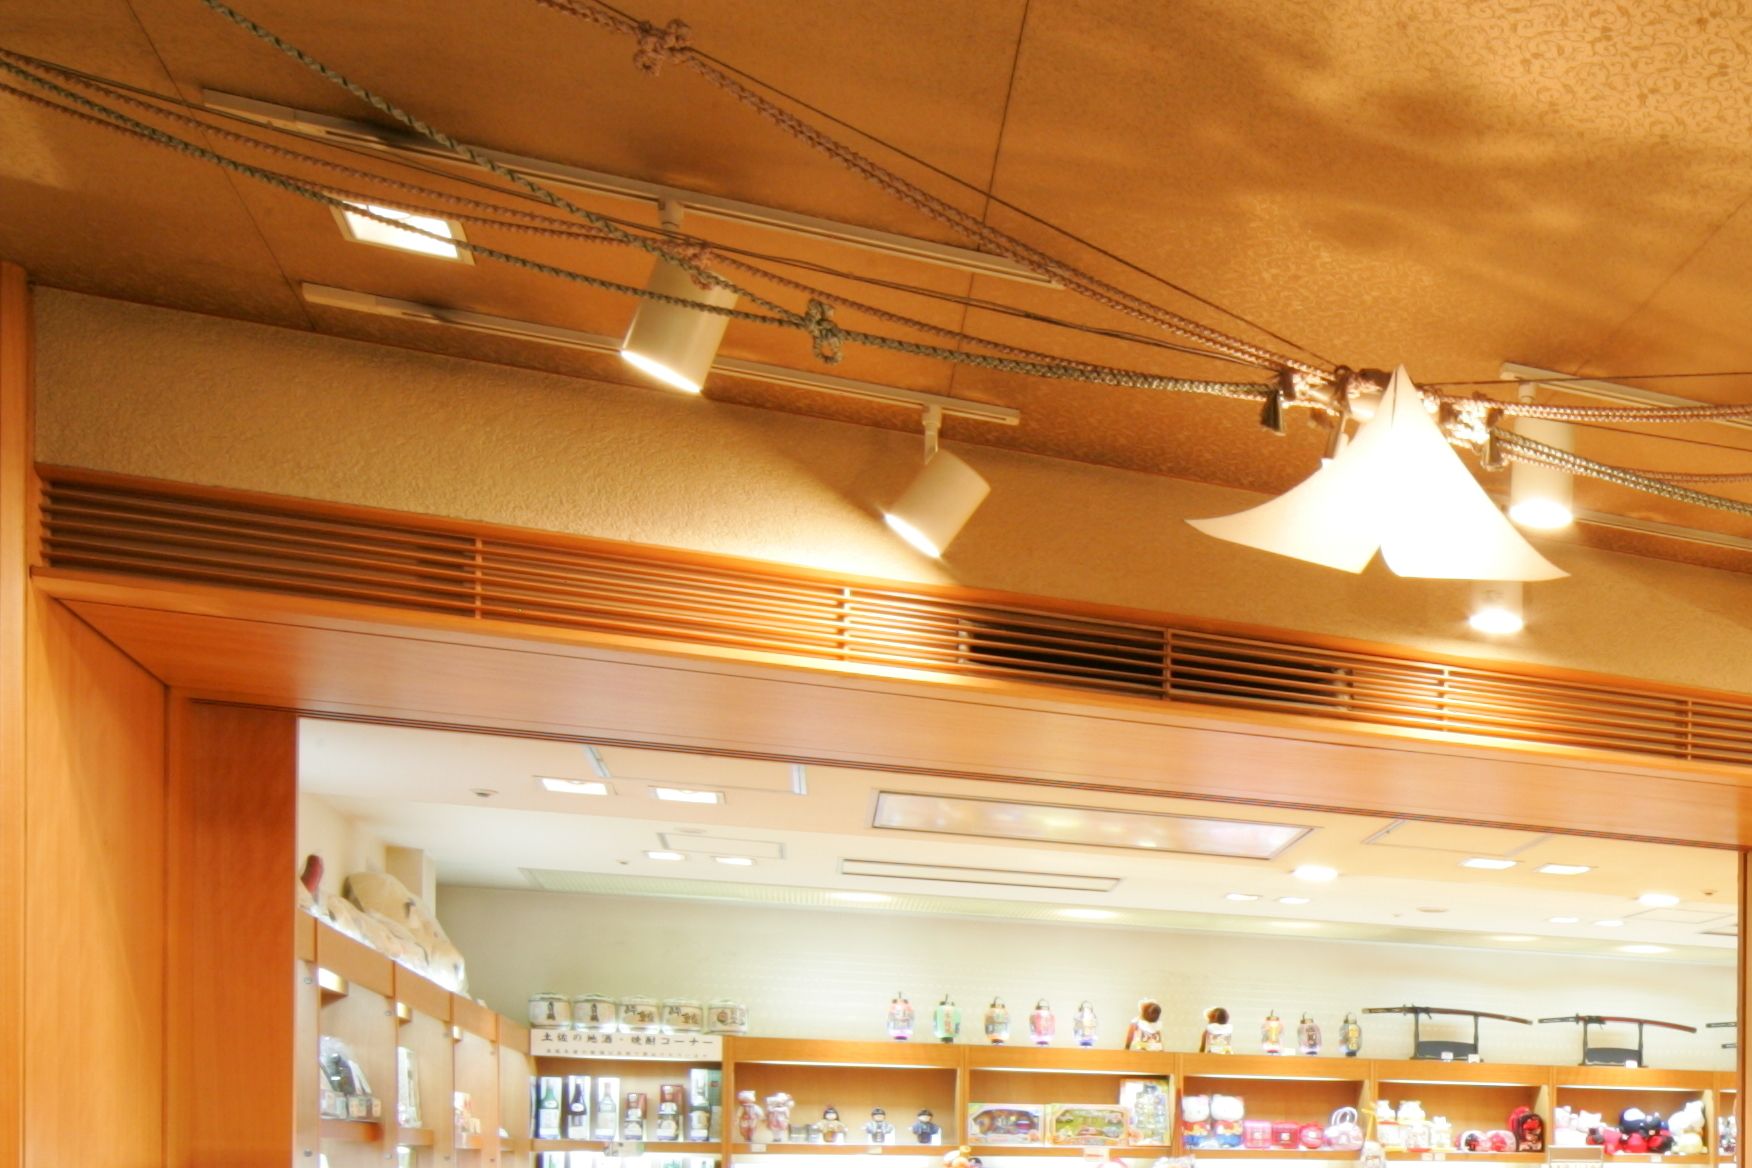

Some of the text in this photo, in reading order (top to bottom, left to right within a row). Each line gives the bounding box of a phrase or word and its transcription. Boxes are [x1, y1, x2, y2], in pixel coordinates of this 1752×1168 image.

[541, 1032, 714, 1046] 土佐の地酒・焼酎コーナー
